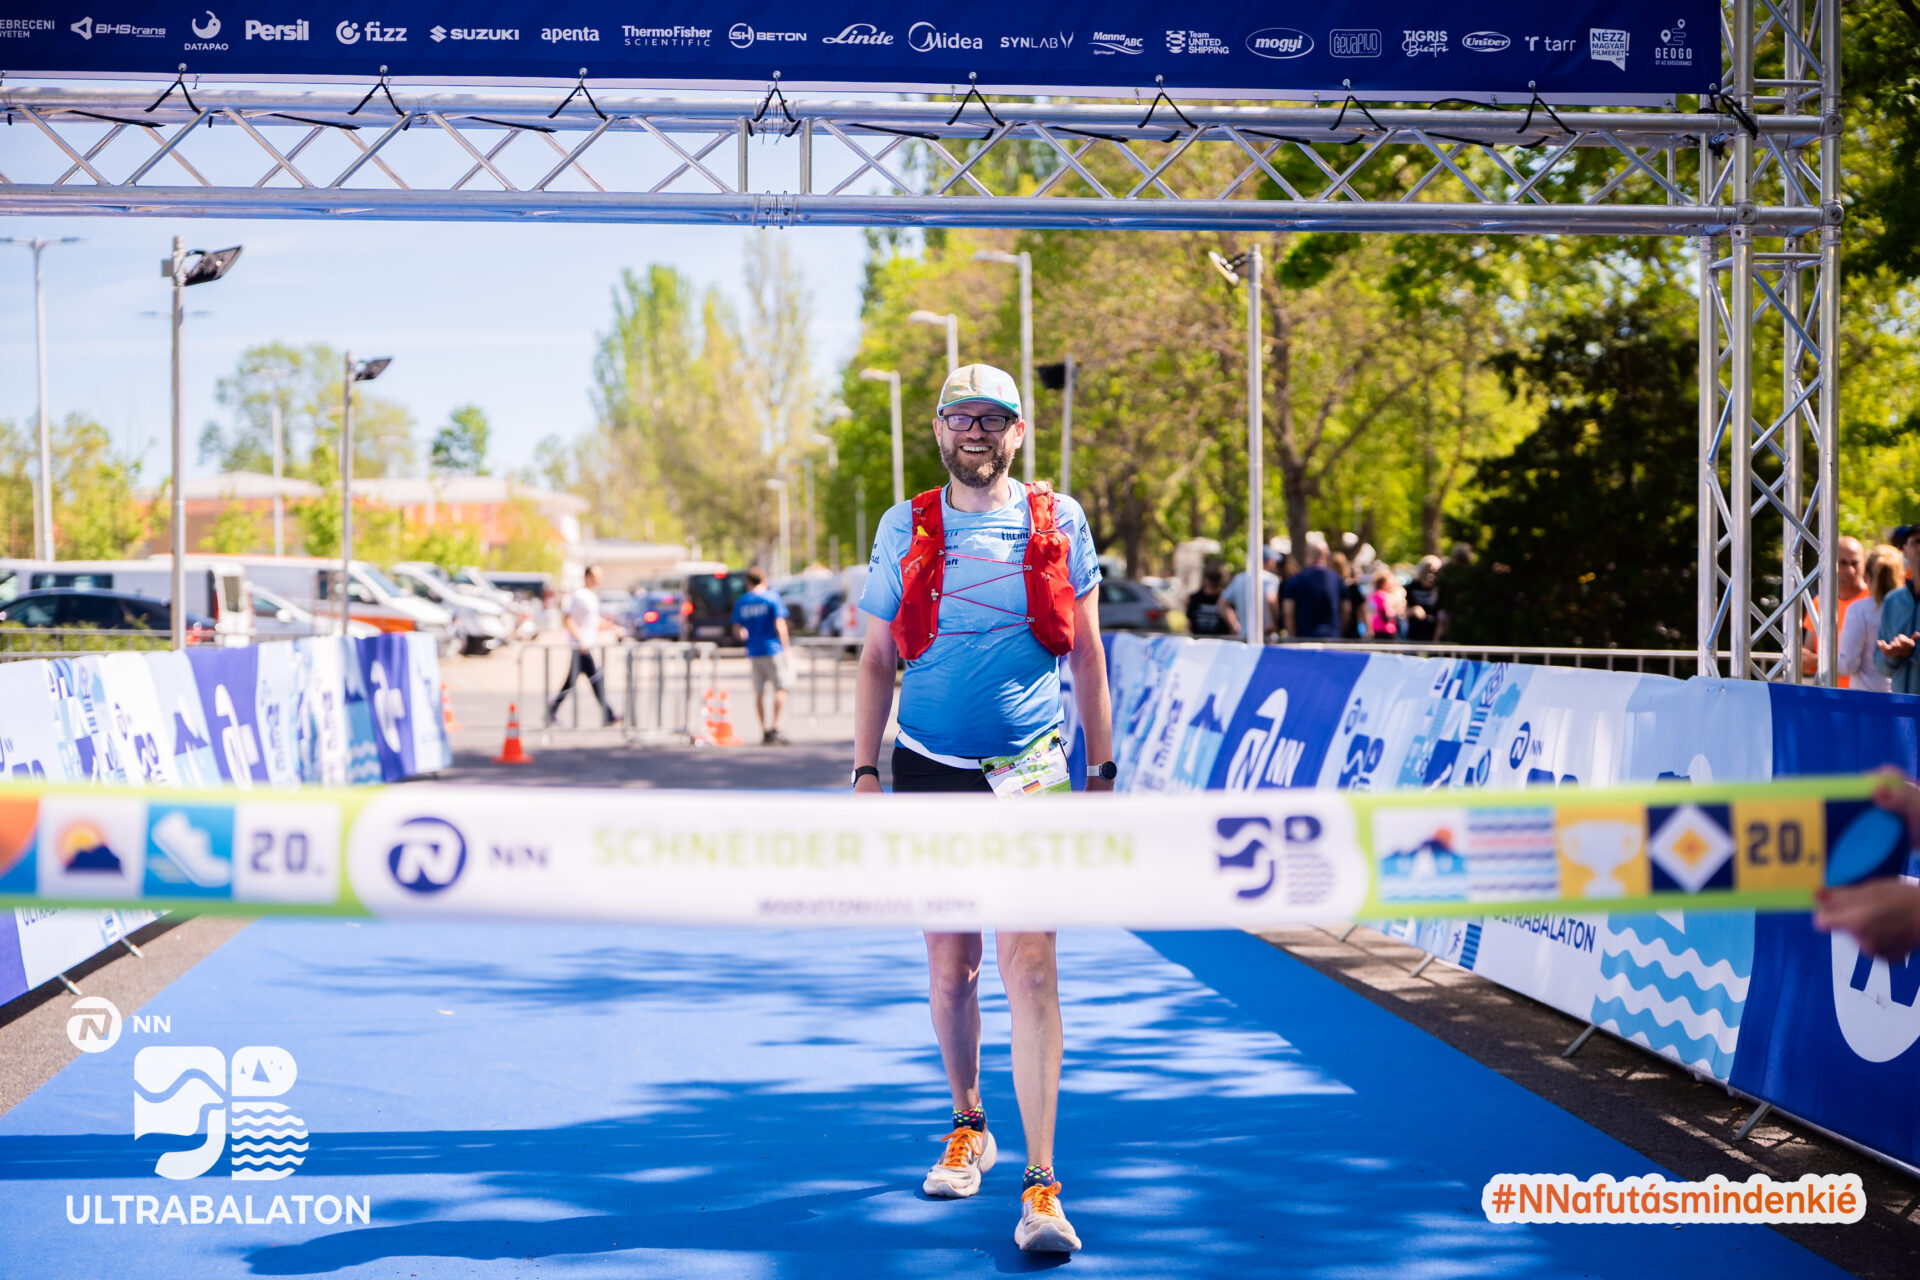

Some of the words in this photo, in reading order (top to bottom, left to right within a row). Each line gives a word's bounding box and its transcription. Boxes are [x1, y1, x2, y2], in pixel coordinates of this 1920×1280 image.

[245, 19, 309, 41] Persil
[364, 21, 407, 42] fizz
[450, 28, 520, 41] SUZUKI
[541, 27, 600, 43] apenta
[822, 23, 894, 46] Linde
[1188, 30, 1210, 39] Team
[1402, 30, 1448, 42] TIGRIS
[1592, 30, 1625, 42] NÉZZ
[624, 38, 711, 47] SCIENTIFIC
[756, 32, 808, 42] BETON
[920, 32, 984, 50] Midea
[1000, 36, 1059, 49] SYNLAB
[1092, 31, 1126, 41] Manna
[1123, 37, 1144, 47] ABC
[1188, 38, 1222, 46] UNITED
[1466, 37, 1509, 47] Univer
[184, 43, 229, 51] DATAPAO
[1188, 46, 1230, 54] SHIPPING
[1255, 35, 1304, 53] mogyi
[1592, 42, 1625, 50] MAGYAR
[1655, 47, 1693, 60] GEOGO
[592, 829, 862, 869] SCHNEIDER
[881, 829, 1137, 869] THORSTEN
